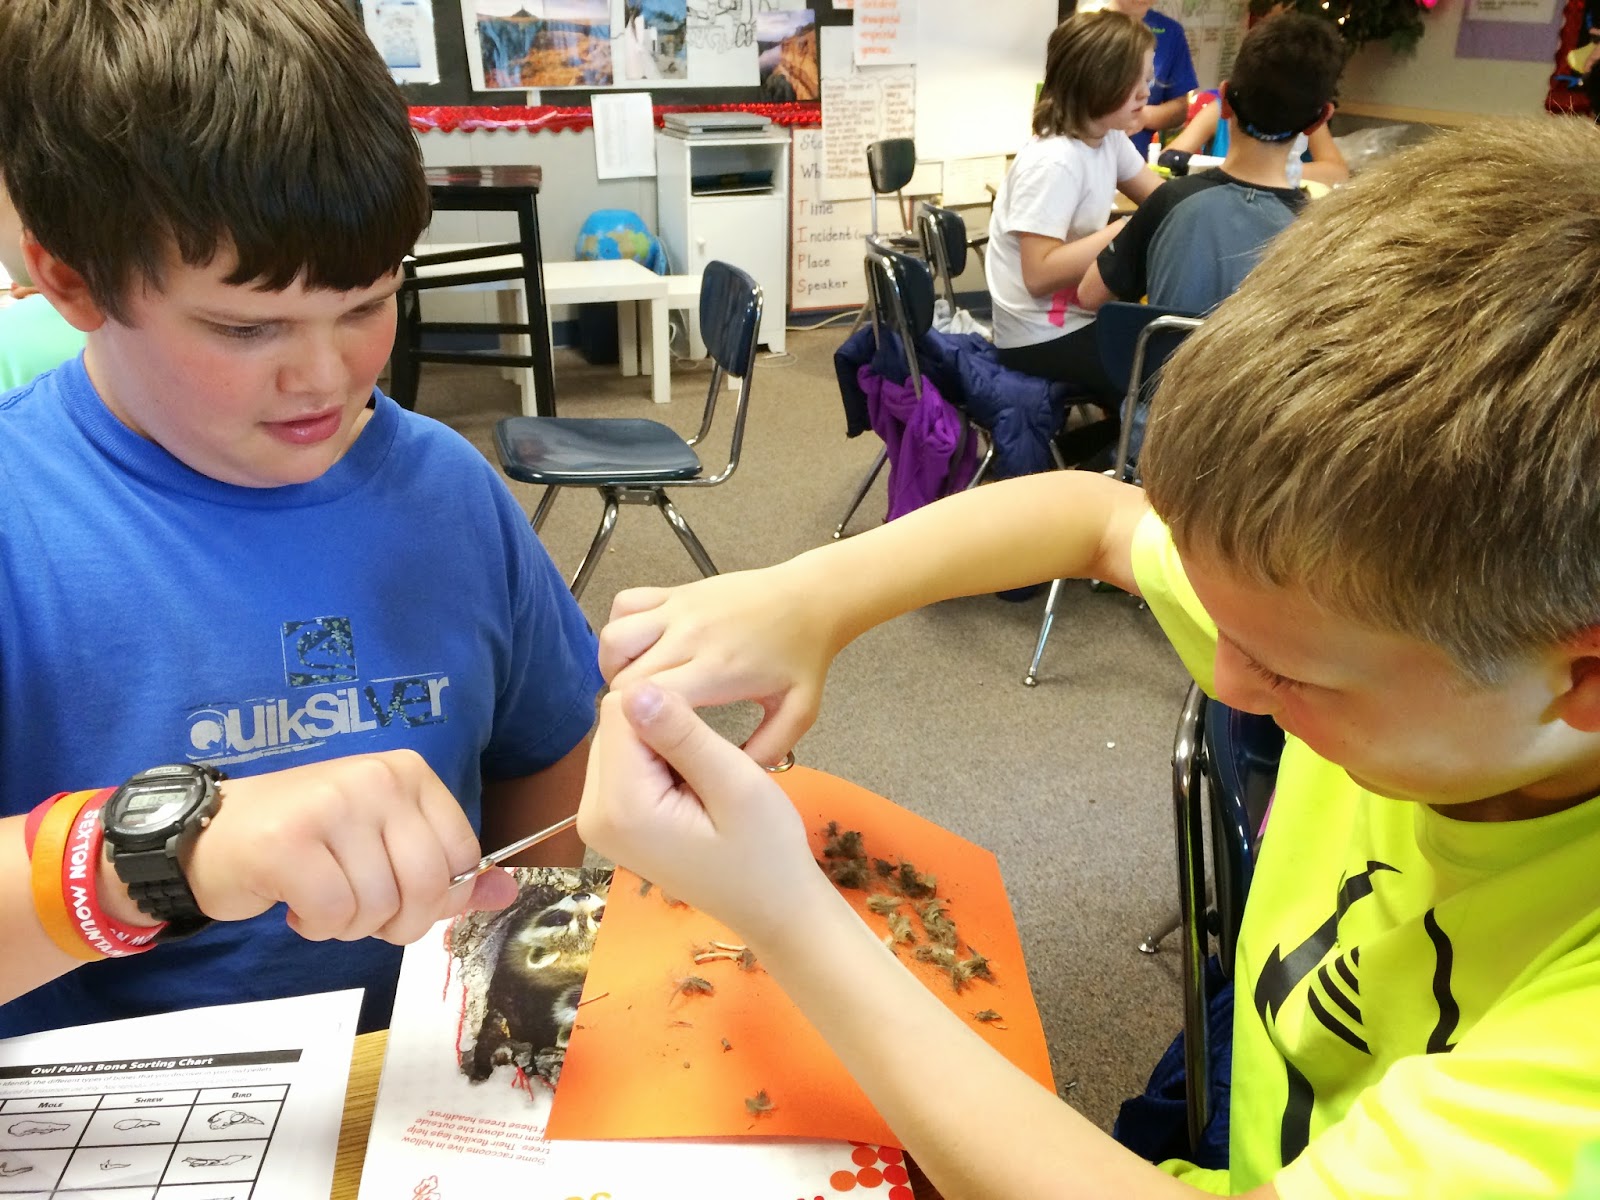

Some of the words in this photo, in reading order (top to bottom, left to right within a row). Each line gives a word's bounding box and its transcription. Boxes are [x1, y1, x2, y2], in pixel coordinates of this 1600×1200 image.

[798, 199, 834, 216] Time
[797, 226, 852, 243] Incident
[798, 254, 831, 271] Place
[797, 278, 849, 295] Speaker
[69, 808, 100, 880] SEXTON
[31, 1066, 56, 1075] Owl
[58, 1064, 93, 1073] Pellet
[96, 1062, 127, 1071] Bone
[129, 1059, 175, 1069] Sorting
[179, 1057, 214, 1067] Chart
[427, 1109, 477, 1124] headfirst.
[415, 1118, 455, 1129] outside
[478, 1118, 506, 1128] trees
[508, 1122, 538, 1133] these
[407, 1125, 428, 1137] help
[430, 1130, 449, 1140] legs
[457, 1125, 475, 1134] the
[476, 1128, 505, 1138] down
[401, 1136, 434, 1148] hollow
[453, 1134, 489, 1146] flexible
[506, 1132, 523, 1140] run
[436, 1141, 446, 1150] in
[447, 1144, 465, 1153] live
[490, 1141, 516, 1151] Their
[466, 1147, 514, 1160] raccoons
[516, 1154, 546, 1166] Some
